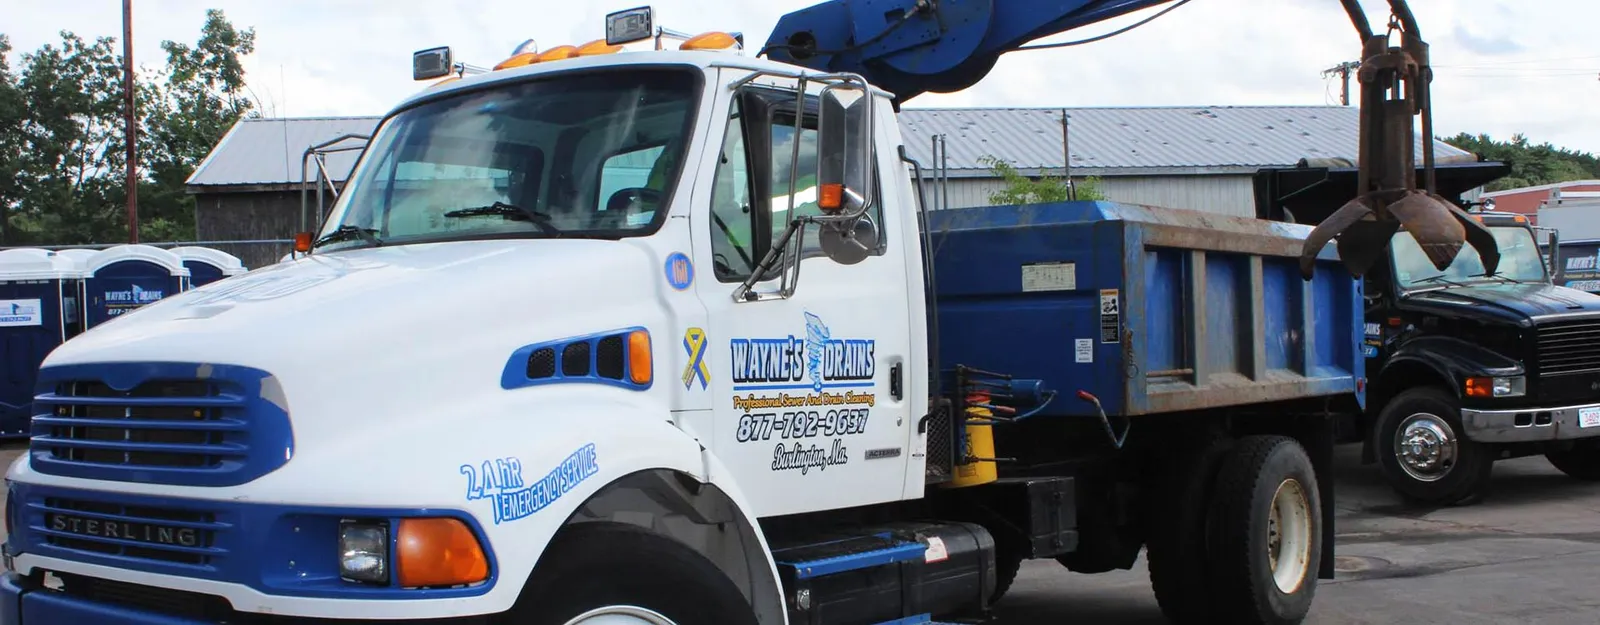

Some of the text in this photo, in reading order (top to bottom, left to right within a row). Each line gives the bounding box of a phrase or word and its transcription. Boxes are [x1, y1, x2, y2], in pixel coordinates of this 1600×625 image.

[105, 290, 131, 301] WAYNE'S
[731, 335, 804, 382] WAYNE'S
[823, 339, 875, 381] DRAINS
[733, 390, 876, 412] Professional Sewer And Drain Cleaning
[736, 408, 869, 443] 877-792-9637
[772, 439, 848, 475] Burlington, Ma.
[460, 459, 502, 525] 24
[501, 443, 599, 522] EMERGENCY SERVICE
[53, 514, 196, 547] STERLING
